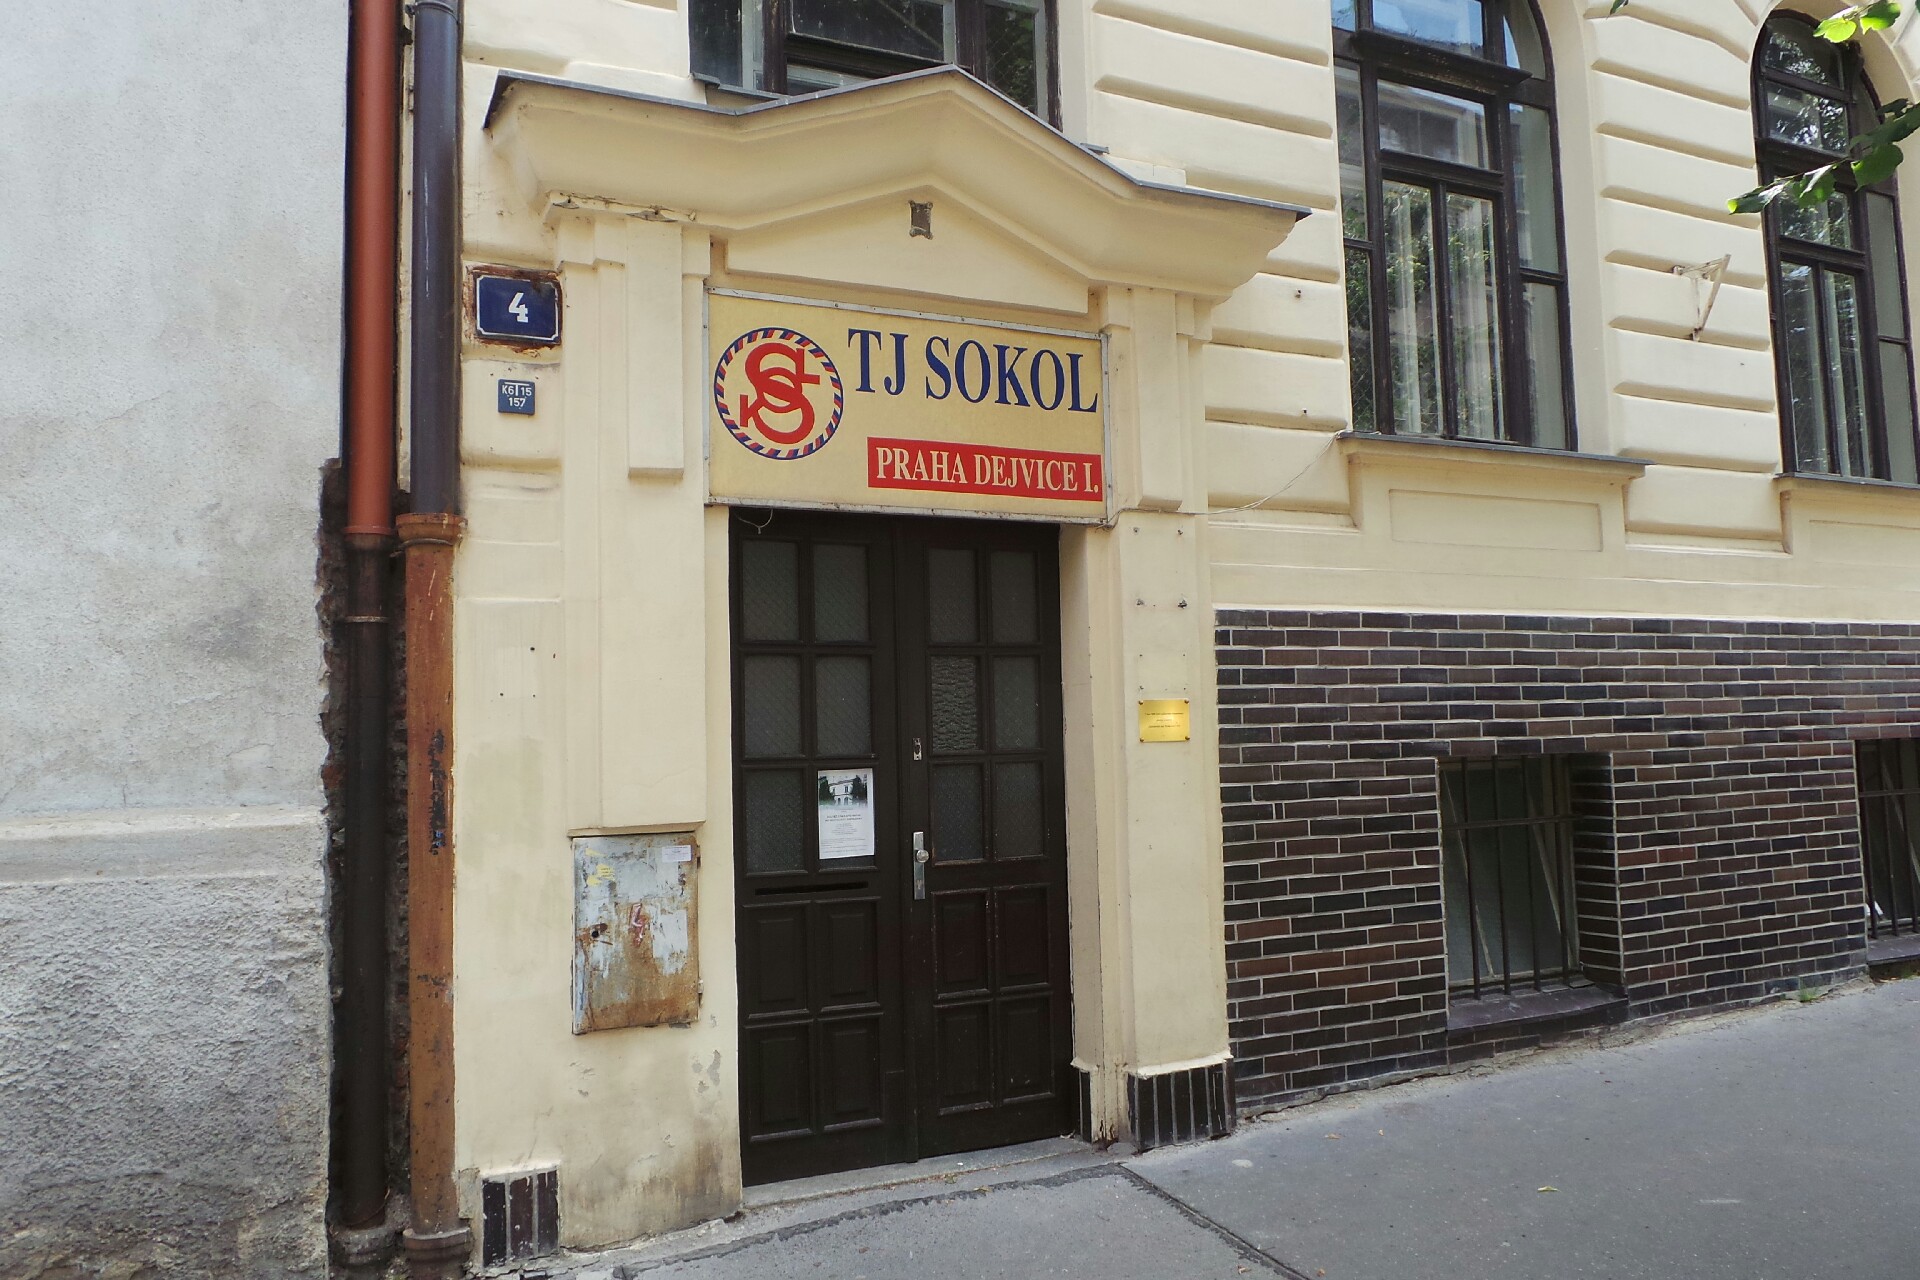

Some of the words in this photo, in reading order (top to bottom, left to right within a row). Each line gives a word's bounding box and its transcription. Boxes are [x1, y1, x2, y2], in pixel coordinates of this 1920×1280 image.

[508, 292, 529, 323] 4
[848, 328, 908, 395] TJ
[925, 336, 1098, 413] SOKOL
[509, 398, 526, 407] 157
[876, 447, 968, 484] PRAHA
[973, 454, 1078, 491] DEJVICE
